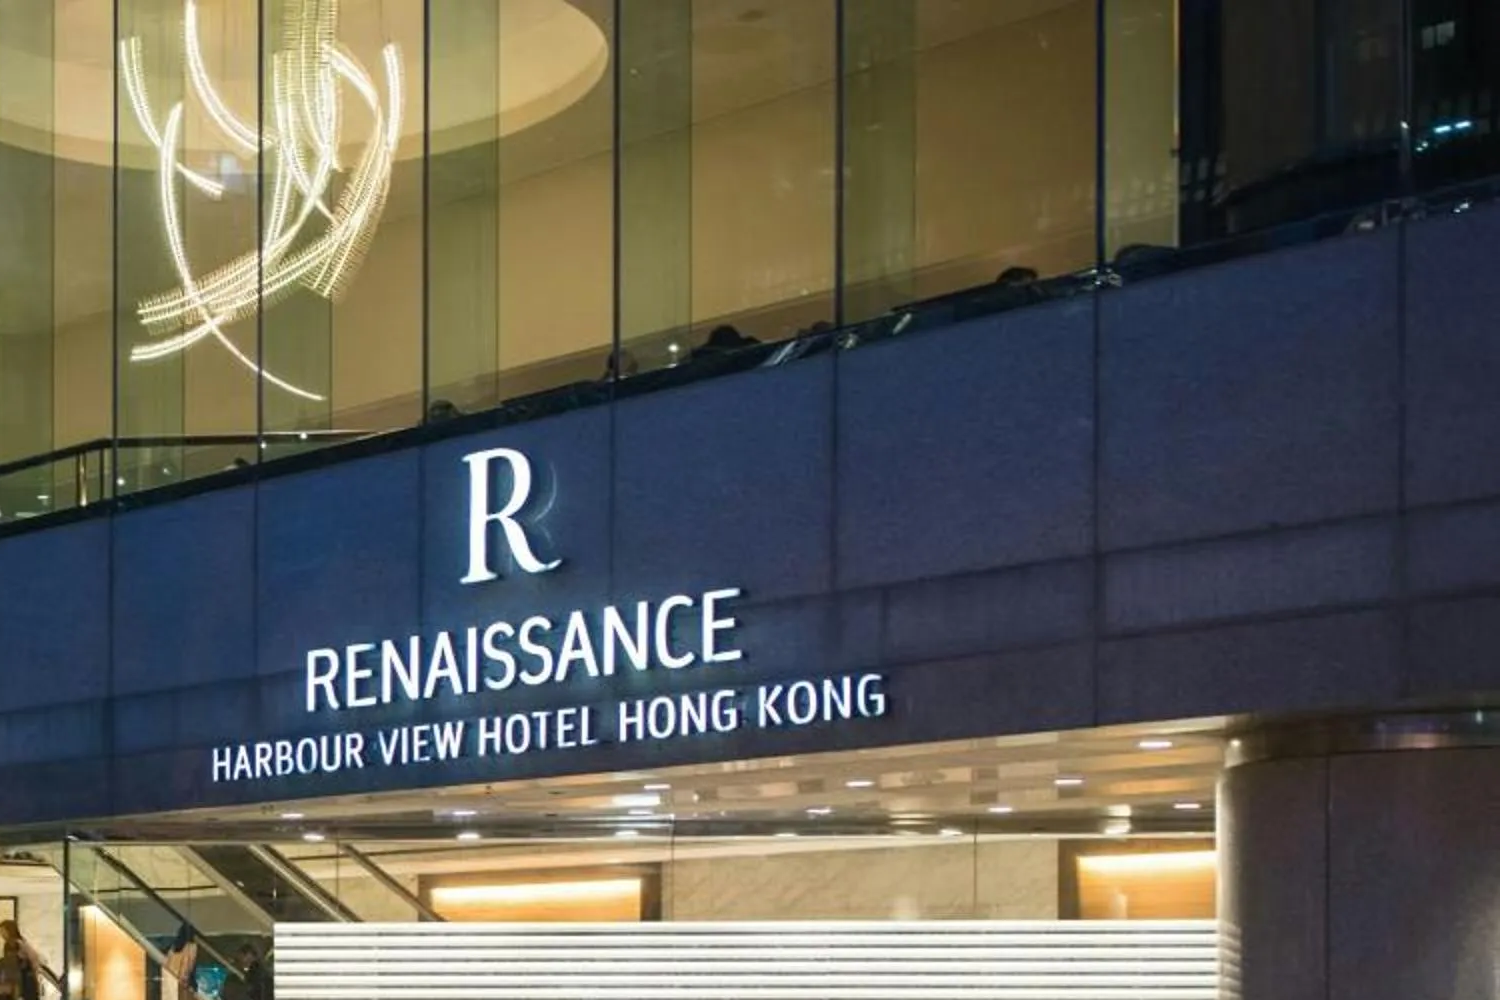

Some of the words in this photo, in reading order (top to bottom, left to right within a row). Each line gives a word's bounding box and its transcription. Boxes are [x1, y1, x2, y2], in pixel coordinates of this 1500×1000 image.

[460, 446, 562, 584] R
[306, 587, 742, 713] RENAISSANCE
[211, 731, 365, 782] HARBOUR
[378, 720, 465, 766] VIEW
[477, 706, 598, 756] HOTEL
[619, 688, 738, 743] HONG
[758, 672, 884, 728] KONG
